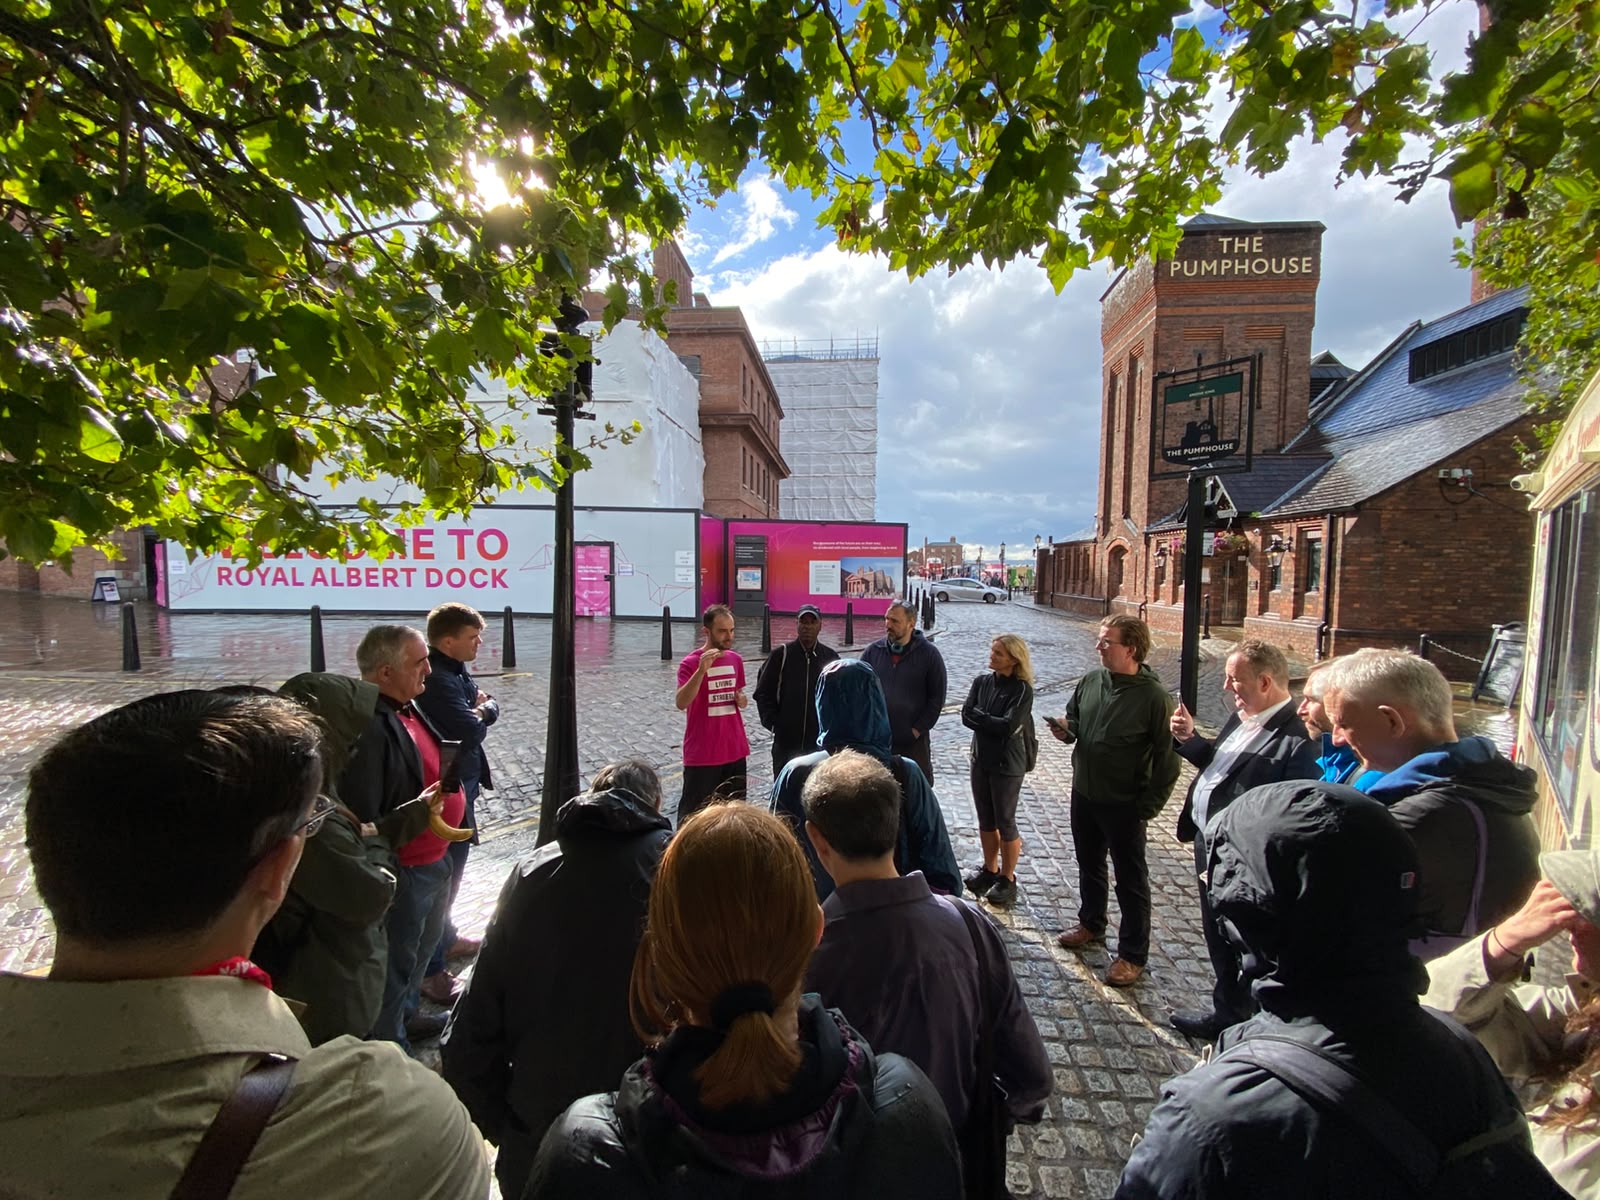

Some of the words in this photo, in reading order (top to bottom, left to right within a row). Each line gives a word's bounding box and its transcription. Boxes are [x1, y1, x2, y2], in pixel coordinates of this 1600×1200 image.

[1218, 236, 1264, 254] THE
[1169, 256, 1313, 278] PUMPHOUSE
[1166, 449, 1182, 457] THE
[1183, 442, 1235, 455] PUMPHOUSE
[447, 528, 509, 561] TO
[216, 566, 305, 587] ROYAL
[310, 567, 417, 588] ALBERT
[425, 567, 509, 589] DOCK
[715, 679, 733, 688] LIVING
